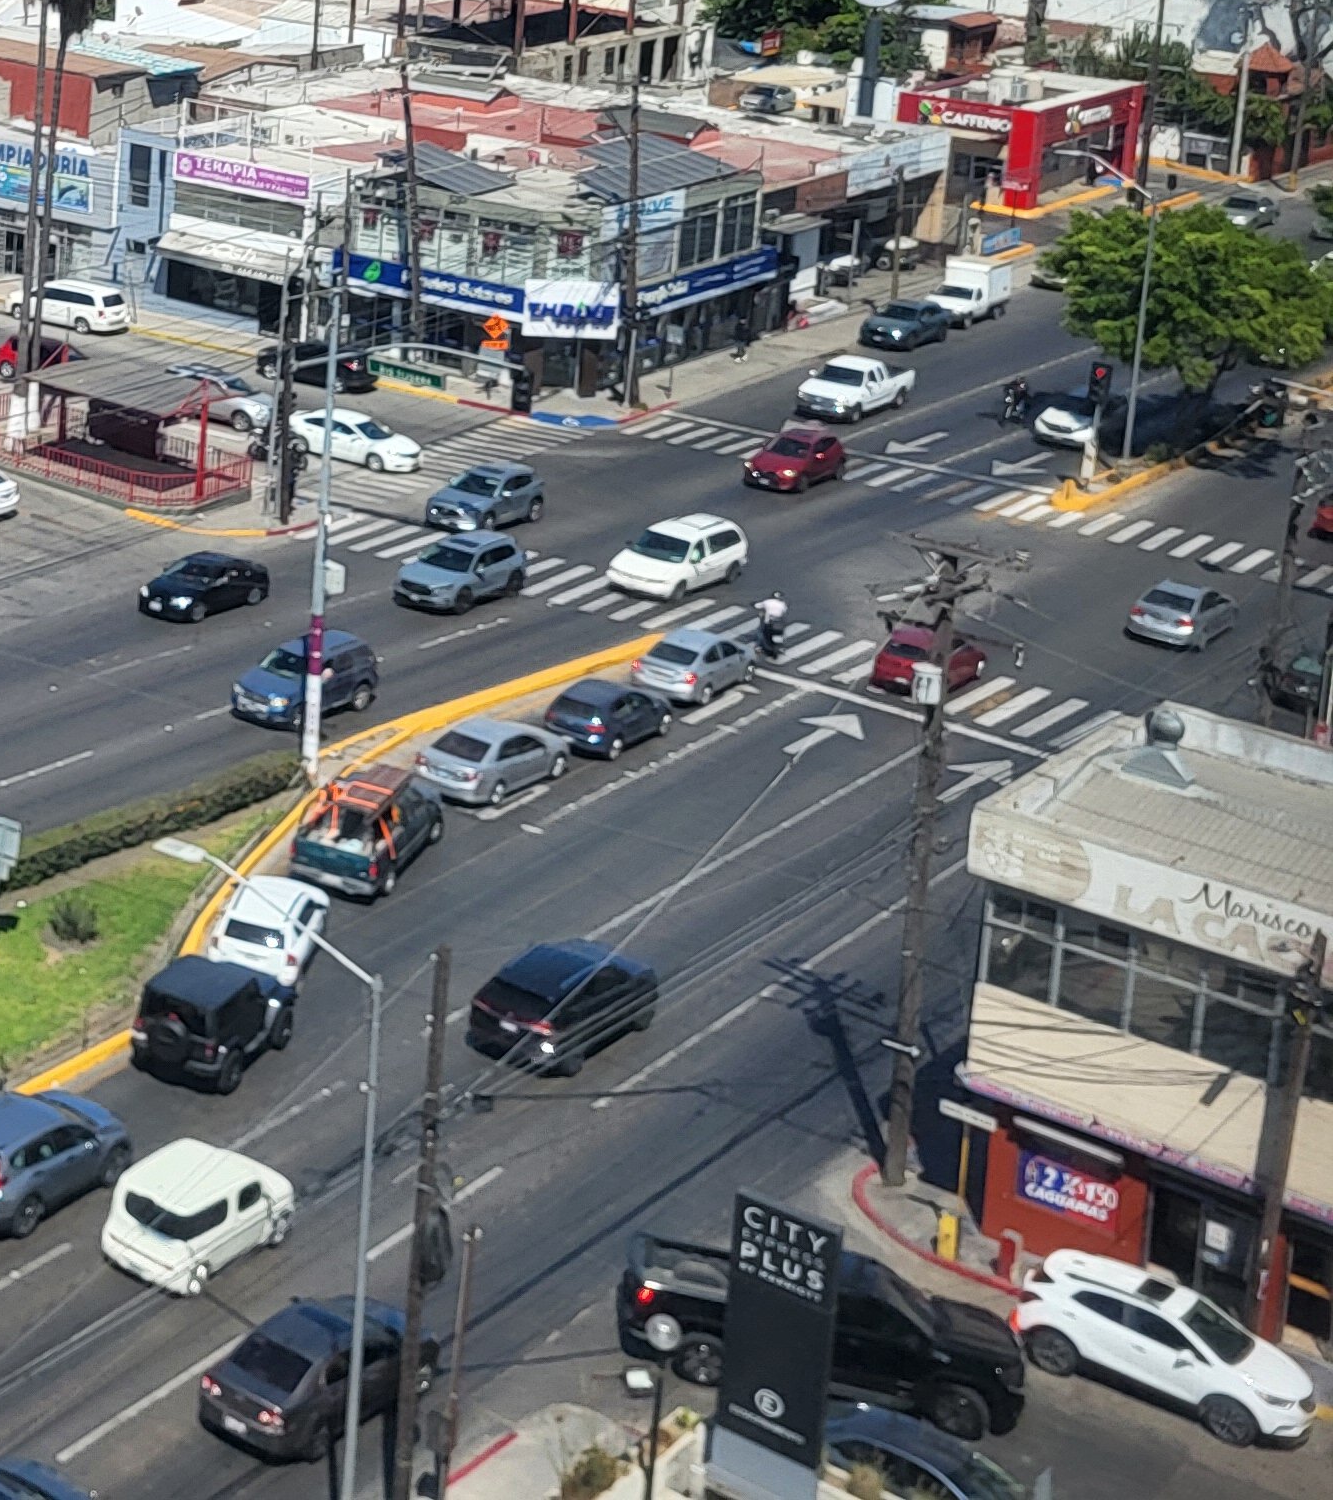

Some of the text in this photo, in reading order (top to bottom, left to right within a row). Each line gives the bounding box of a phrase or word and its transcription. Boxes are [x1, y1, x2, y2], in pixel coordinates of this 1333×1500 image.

[941, 110, 1013, 133] CAFFENIO
[194, 157, 258, 180] TERAPIA
[743, 1206, 828, 1255] CITY
[740, 1240, 826, 1291] PLUS
